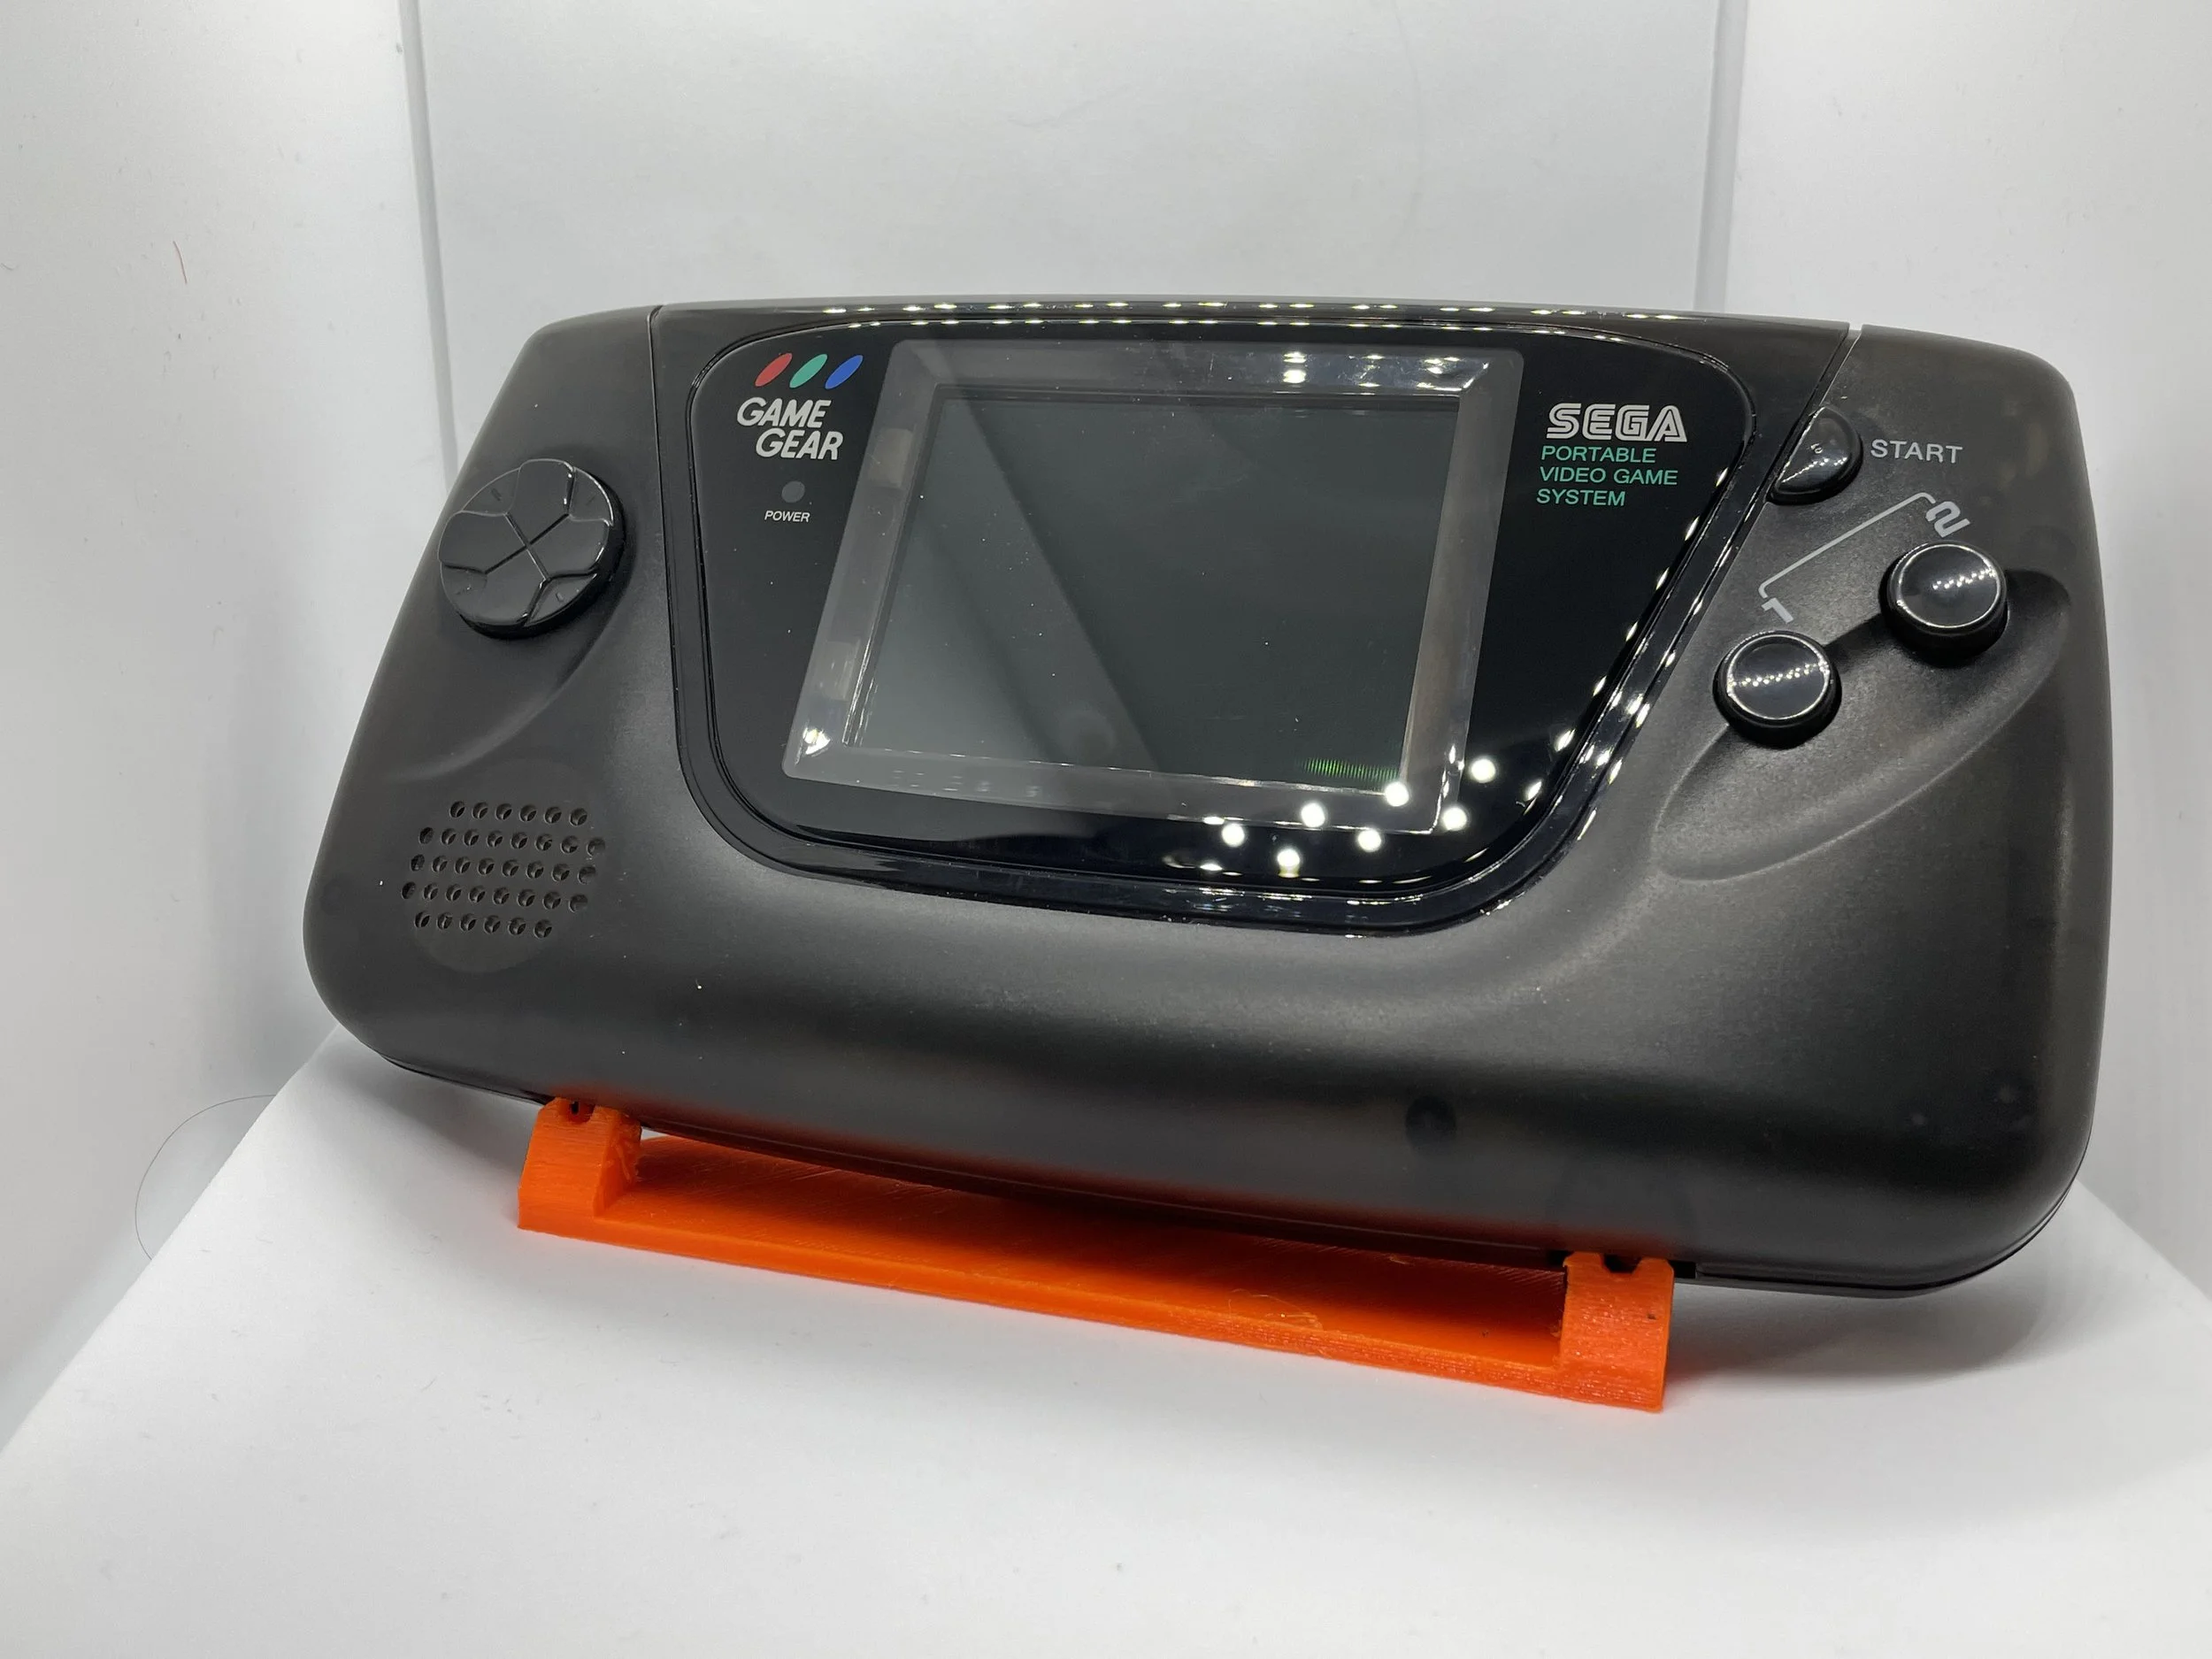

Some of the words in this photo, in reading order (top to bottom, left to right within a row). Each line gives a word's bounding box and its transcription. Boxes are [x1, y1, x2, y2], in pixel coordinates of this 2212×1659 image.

[737, 396, 832, 428] GAME
[1546, 403, 1687, 442] SEGA
[756, 428, 844, 460] GEAR
[1541, 445, 1657, 464] PORTABLE
[1870, 439, 1963, 464] START
[1540, 466, 1607, 483] VIDEO
[1613, 468, 1678, 486] GAME
[1536, 488, 1626, 506] SYSTEM
[764, 510, 811, 523] POWER
[1925, 501, 1971, 538] 2
[1761, 597, 1794, 623] 1
